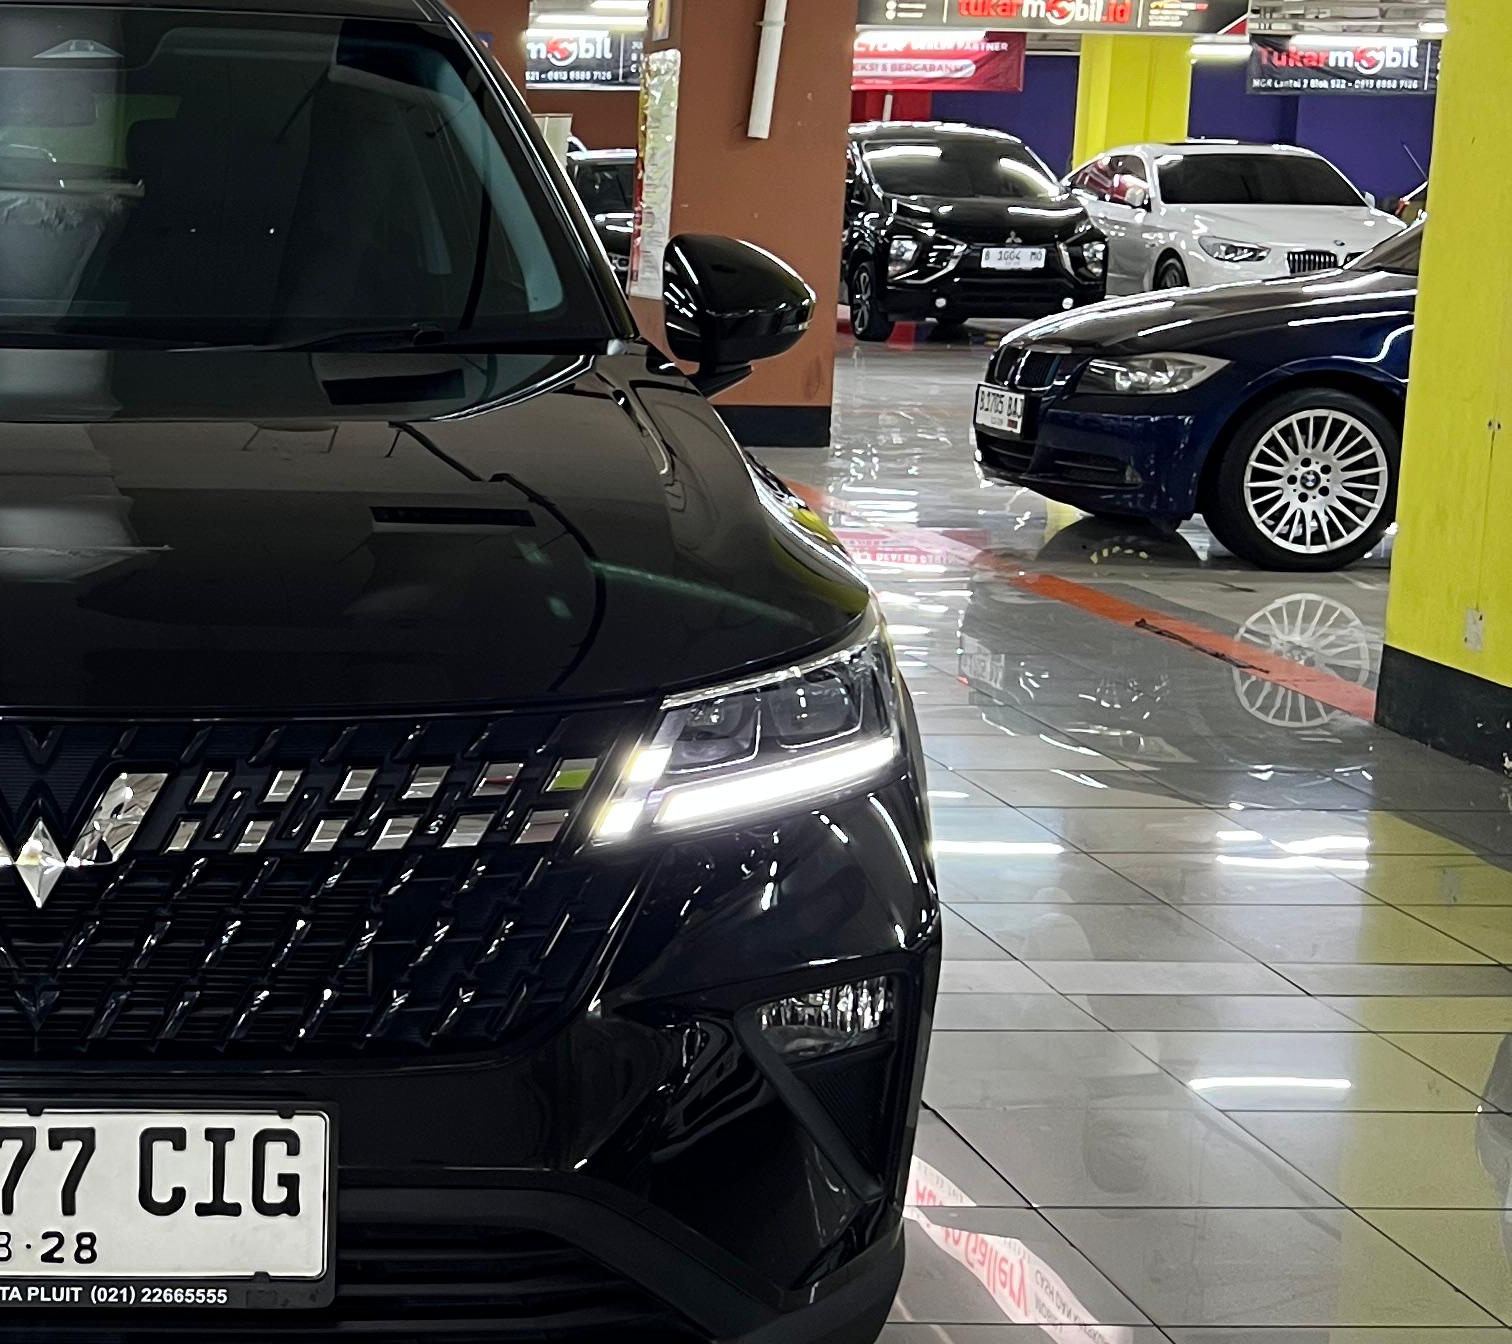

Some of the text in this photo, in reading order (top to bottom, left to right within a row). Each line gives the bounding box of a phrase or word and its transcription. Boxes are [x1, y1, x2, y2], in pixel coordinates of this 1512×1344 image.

[138, 1126, 301, 1218] CIG
[27, 1286, 83, 1303] PLUIT
[90, 1286, 136, 1305] (021)
[140, 1287, 228, 1304] 22665555
